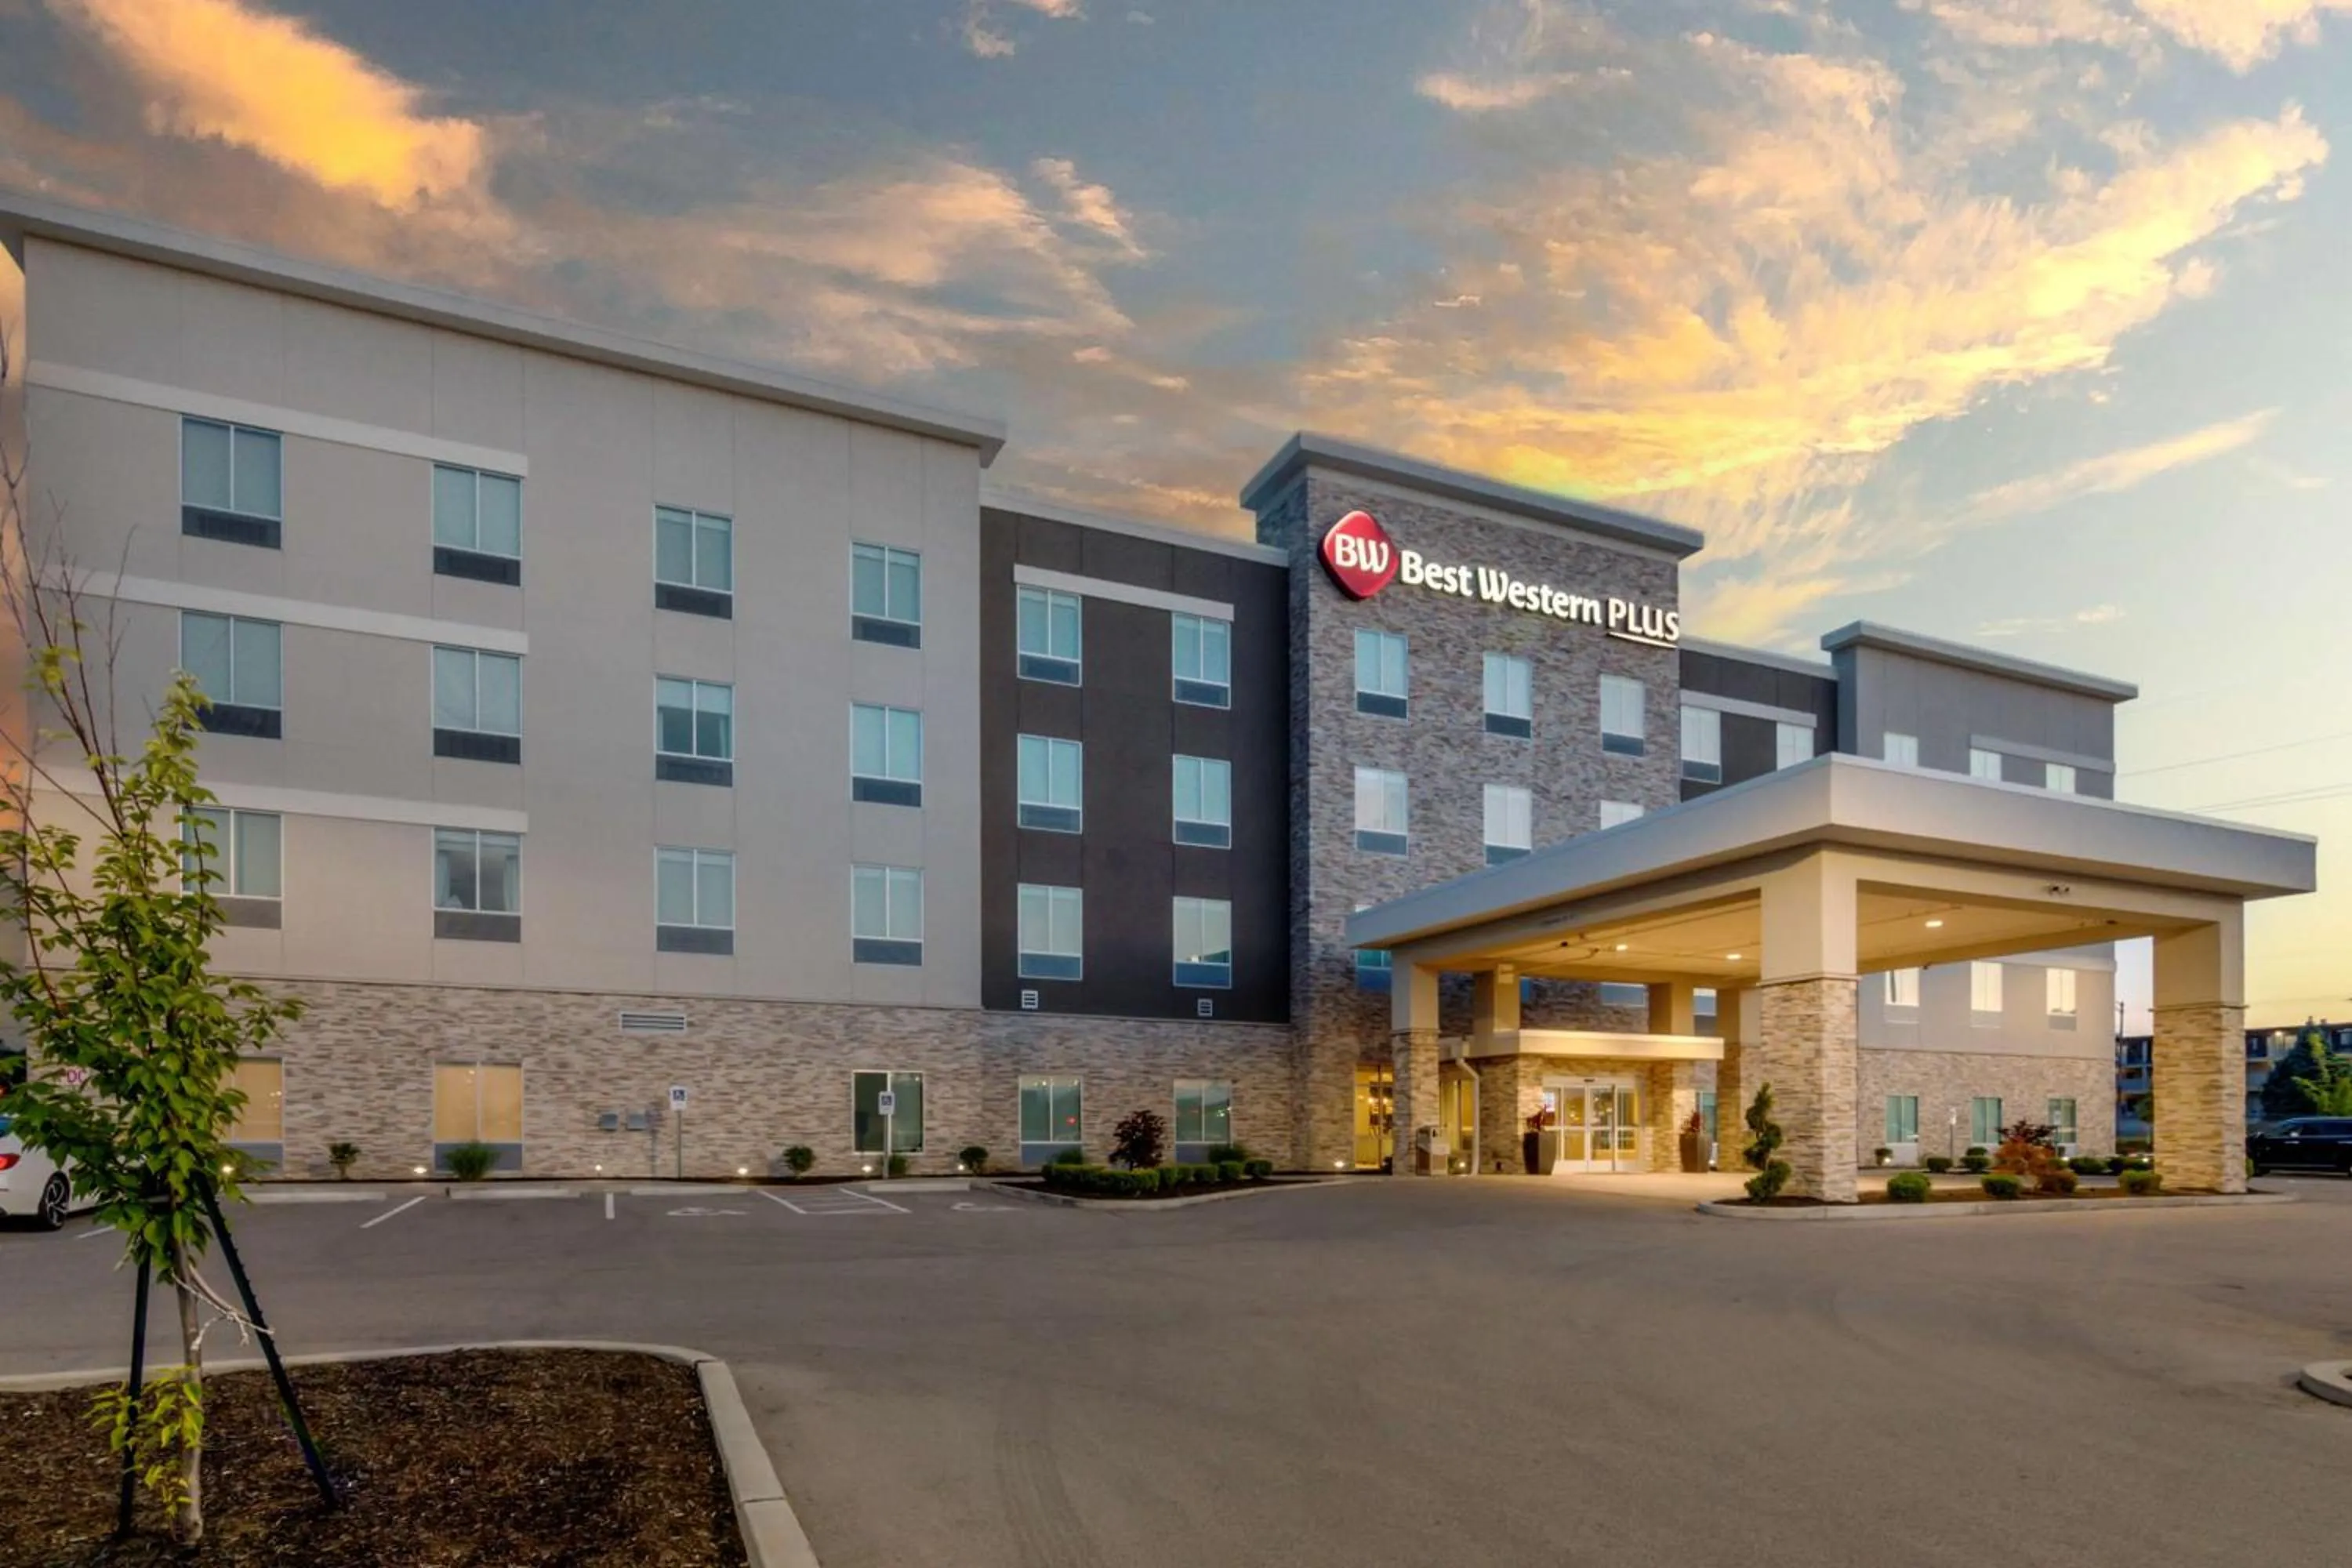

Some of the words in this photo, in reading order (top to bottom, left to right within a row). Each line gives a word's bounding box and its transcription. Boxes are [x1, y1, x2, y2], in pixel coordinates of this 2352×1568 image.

[1334, 533, 1389, 574] BW
[1401, 550, 1473, 597] Best
[1478, 567, 1602, 624] Western
[1608, 597, 1679, 641] PLUS
